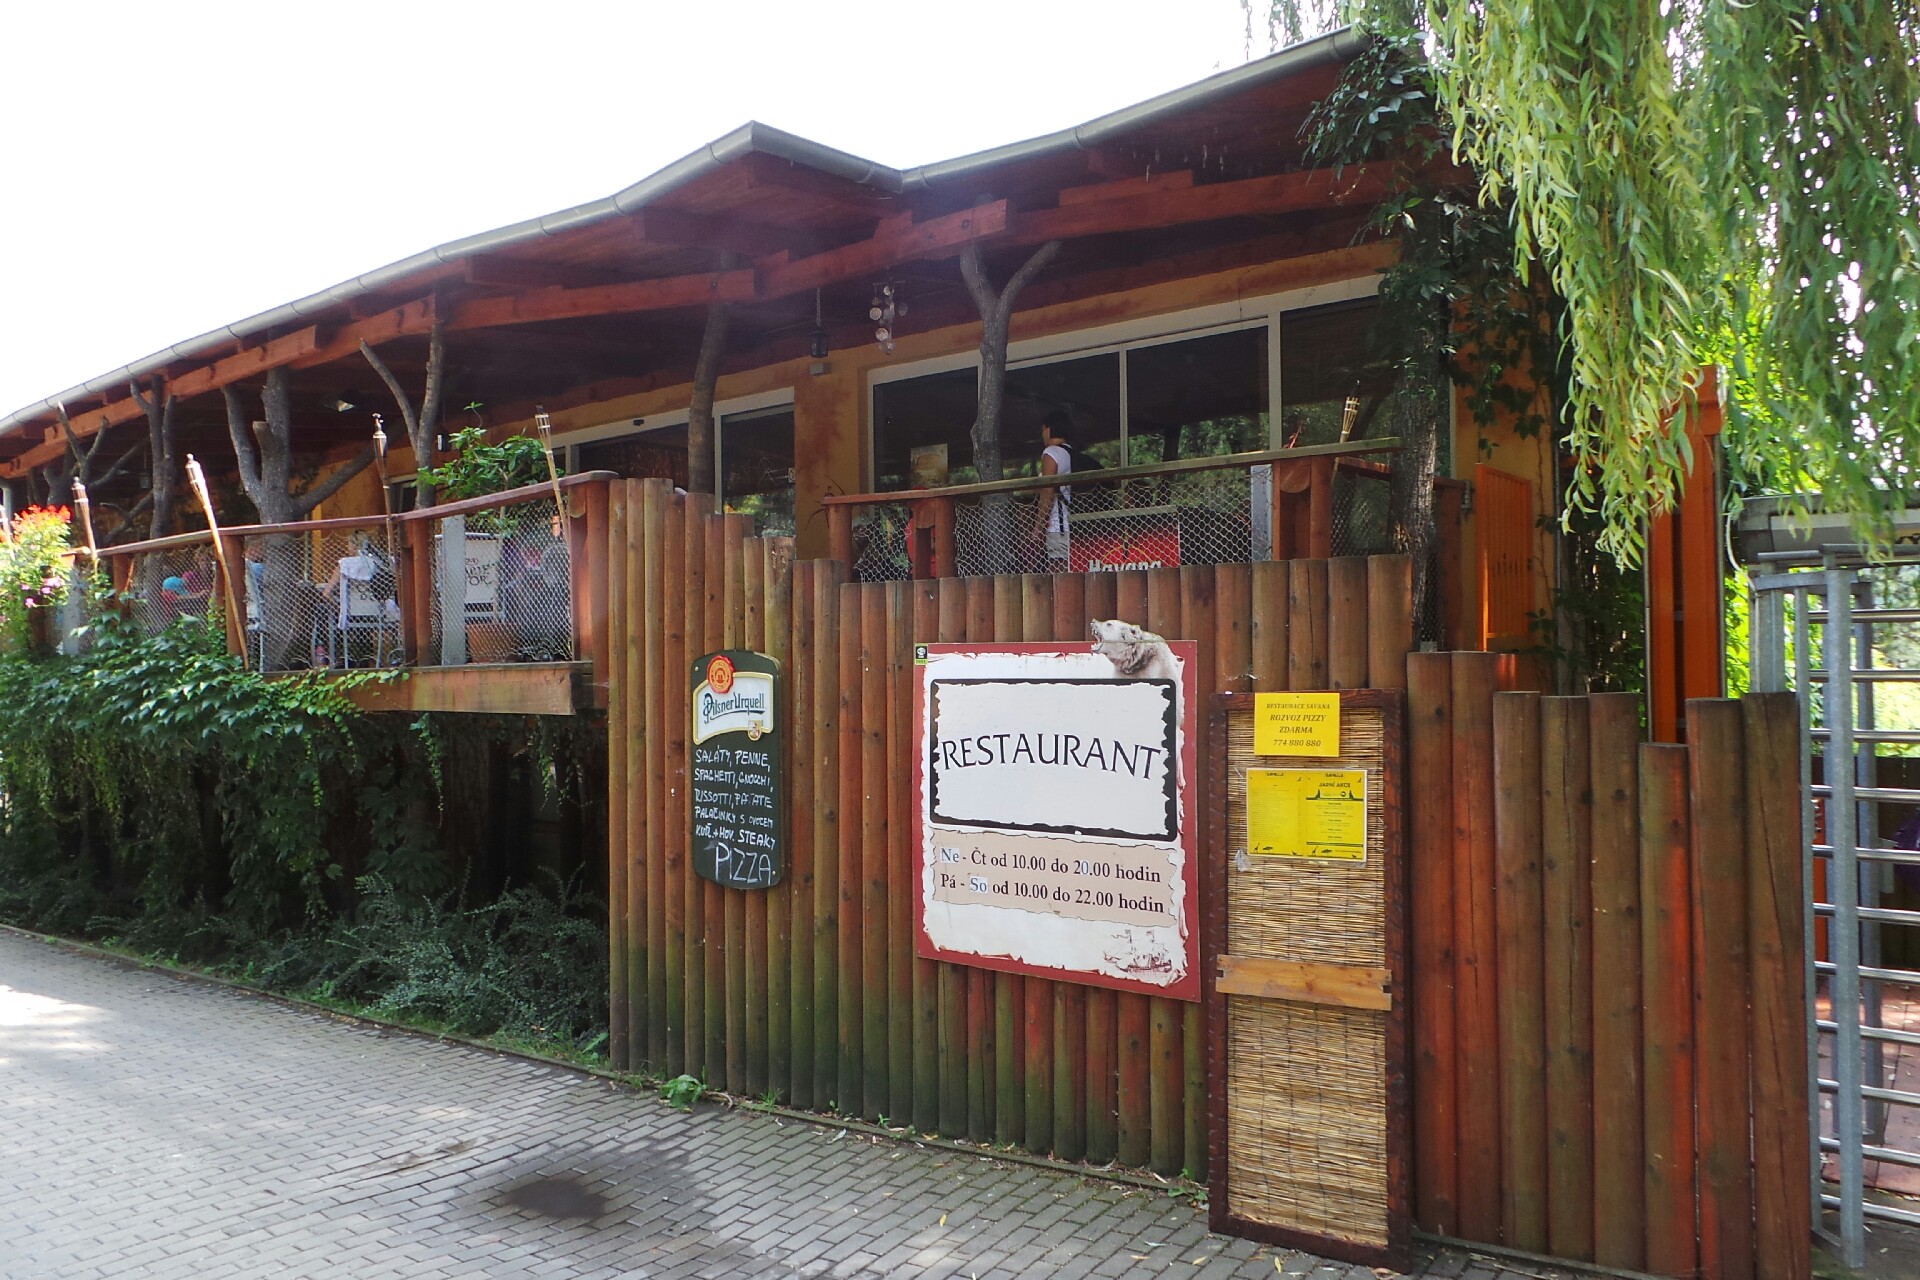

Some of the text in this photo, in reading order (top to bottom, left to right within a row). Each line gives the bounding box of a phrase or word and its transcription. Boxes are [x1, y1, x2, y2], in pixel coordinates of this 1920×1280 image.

[1088, 559, 1162, 573] Havana
[703, 691, 765, 724] Pilsner Urquell
[695, 744, 770, 772] SALÁTY, PENNE,
[941, 733, 1161, 780] RESTAURANT
[737, 829, 776, 851] STEAKY
[715, 841, 771, 886] PIZZA
[941, 847, 960, 863] Ne
[971, 846, 987, 866] Čt
[990, 853, 1007, 867] od
[1012, 854, 1046, 871] 10.00
[1051, 858, 1069, 874] do
[1073, 859, 1110, 878] 20.00
[1115, 864, 1161, 883] hodin
[941, 873, 956, 889] Pá
[970, 877, 987, 893] So
[992, 880, 1009, 895] od
[1015, 882, 1048, 900] 10.00
[1052, 886, 1070, 903] do
[1075, 888, 1113, 907] 22.00
[1118, 893, 1165, 914] hodin
